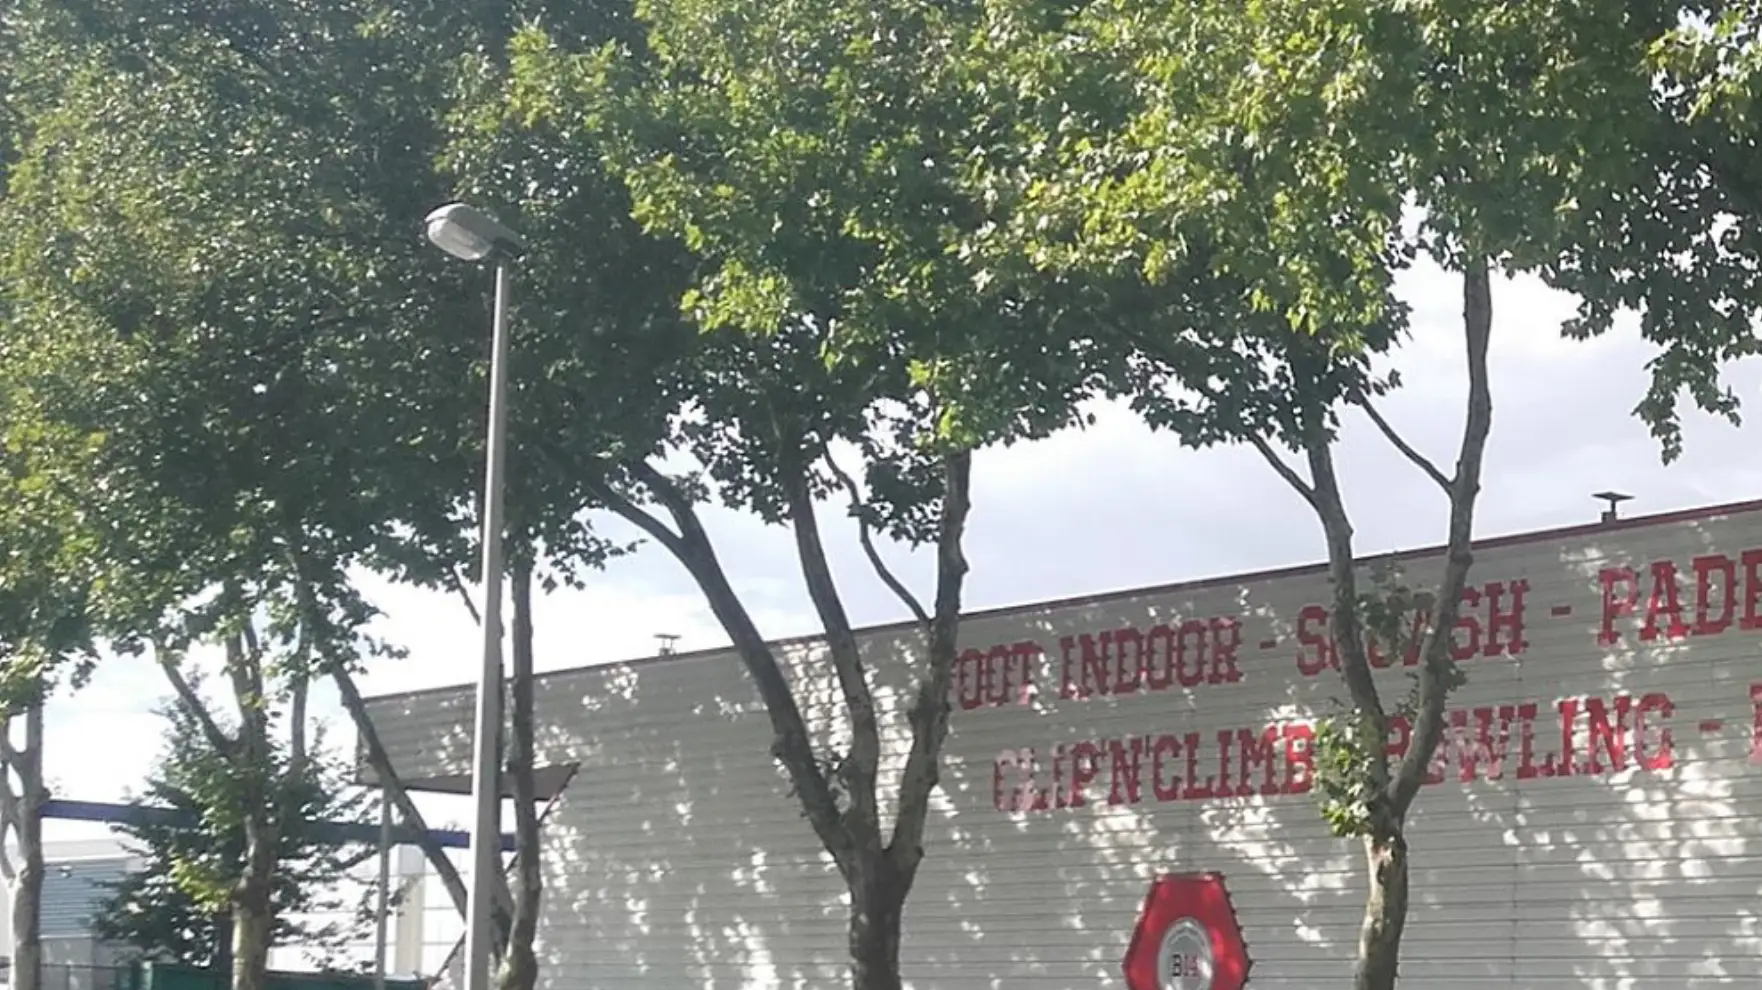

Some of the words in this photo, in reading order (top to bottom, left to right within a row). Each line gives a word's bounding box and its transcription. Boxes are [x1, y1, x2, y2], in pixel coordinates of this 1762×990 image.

[951, 641, 1044, 709] OOT
[1060, 616, 1243, 699] INDOOR
[1296, 578, 1530, 676] SASH
